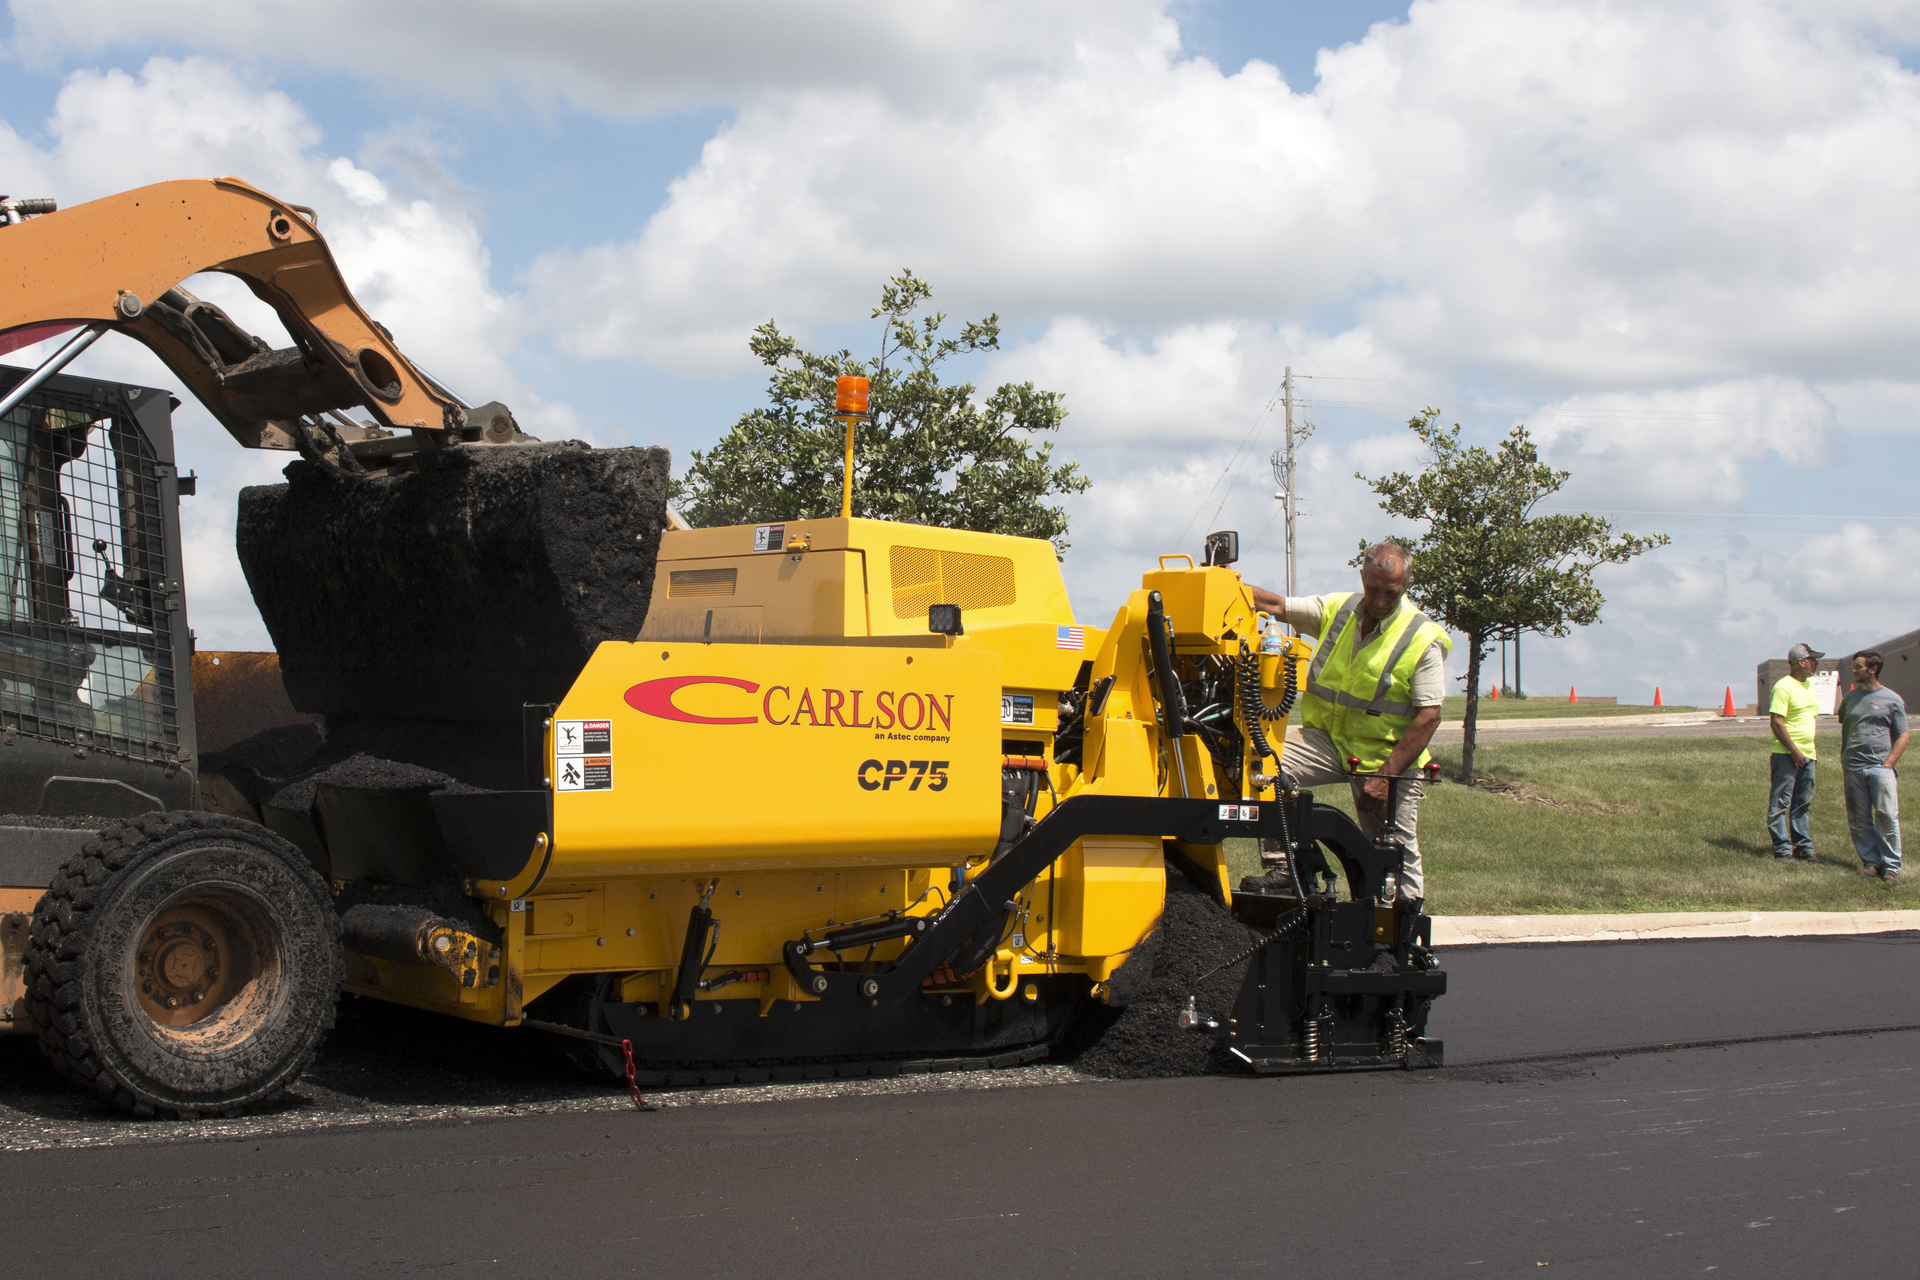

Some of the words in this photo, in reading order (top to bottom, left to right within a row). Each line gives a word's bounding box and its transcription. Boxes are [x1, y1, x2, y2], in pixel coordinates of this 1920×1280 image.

[763, 685, 955, 732] CARLSON
[887, 732, 911, 741] Astec
[913, 734, 950, 744] company
[857, 759, 950, 792] CP75
